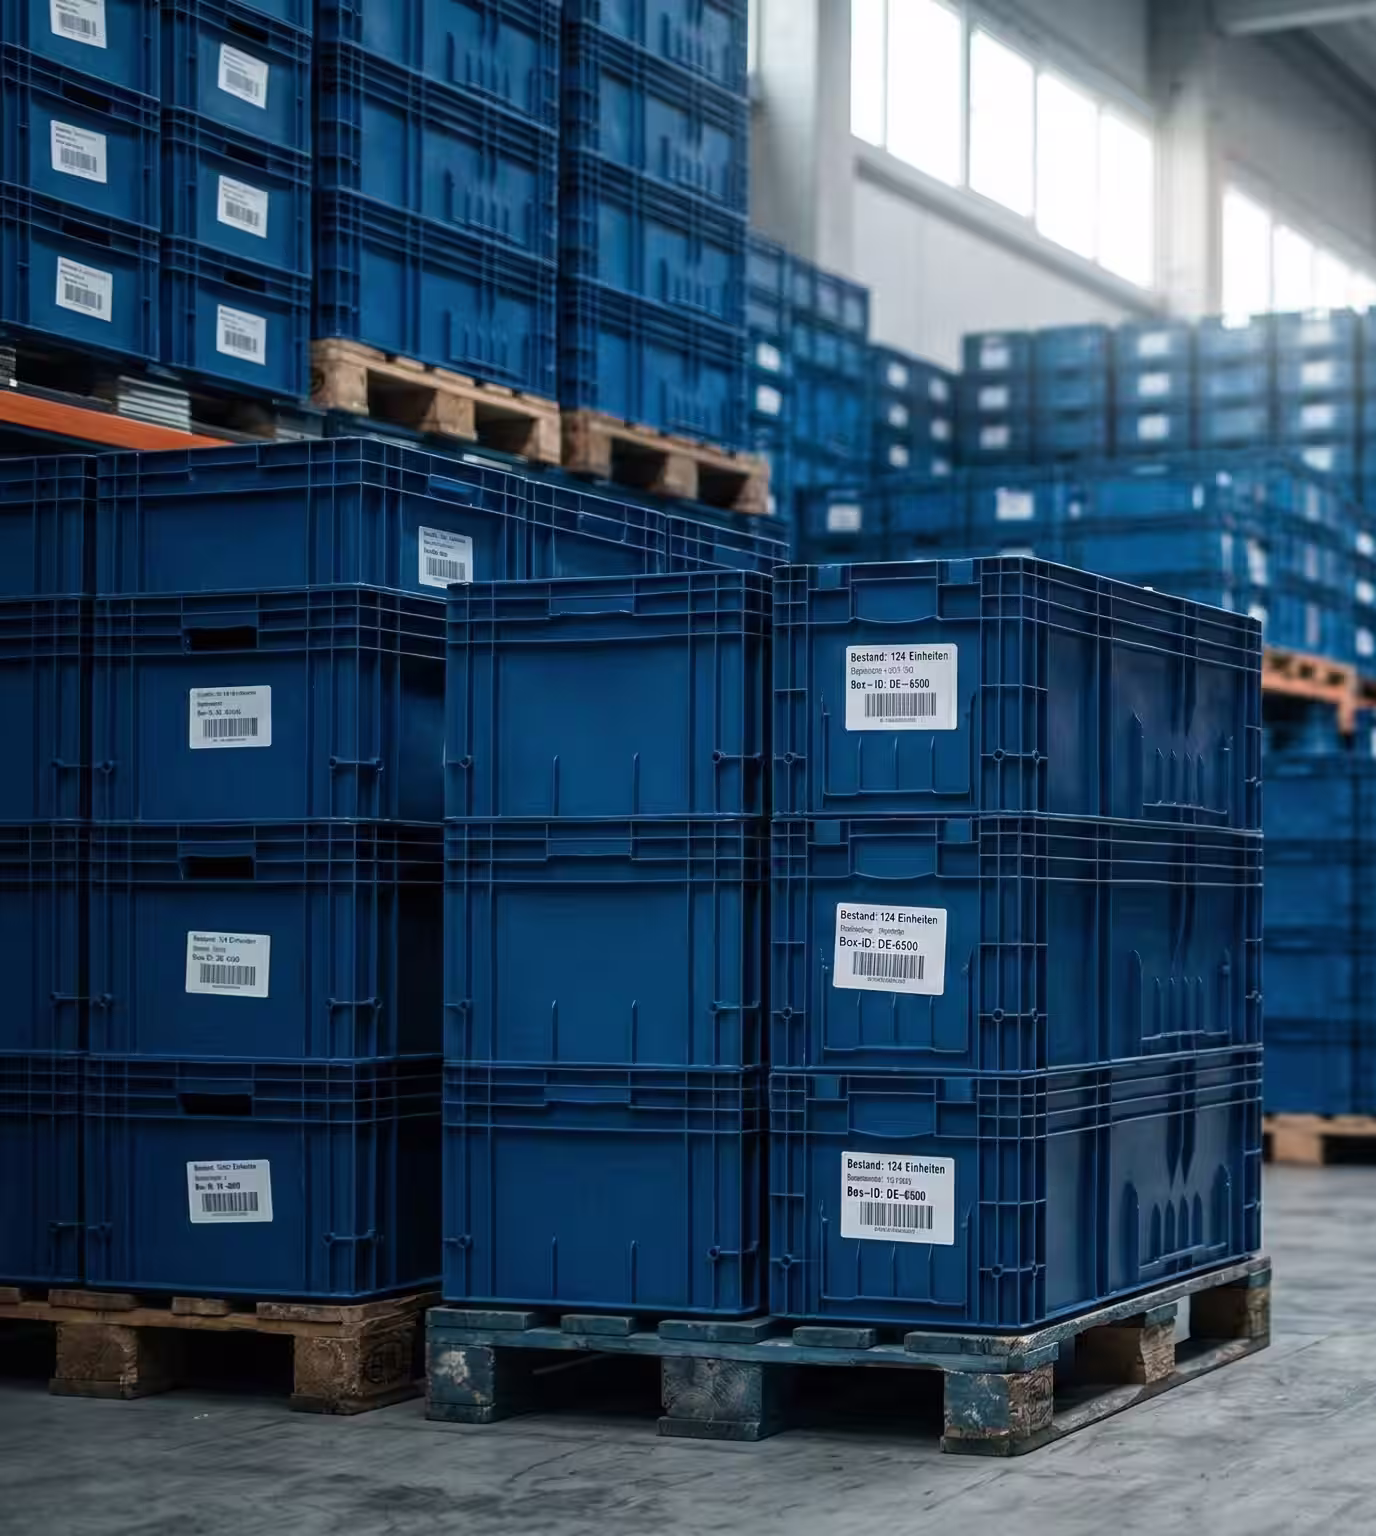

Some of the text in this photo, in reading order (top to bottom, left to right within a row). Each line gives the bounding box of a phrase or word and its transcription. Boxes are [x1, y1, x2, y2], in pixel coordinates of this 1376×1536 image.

[850, 650, 949, 662] Bestand: 124 Einheiten
[840, 910, 938, 925] Bestand: 124 Einheiten
[878, 938, 919, 952] DE-6500
[847, 1158, 946, 1175] Bestand: 124 Einheiten
